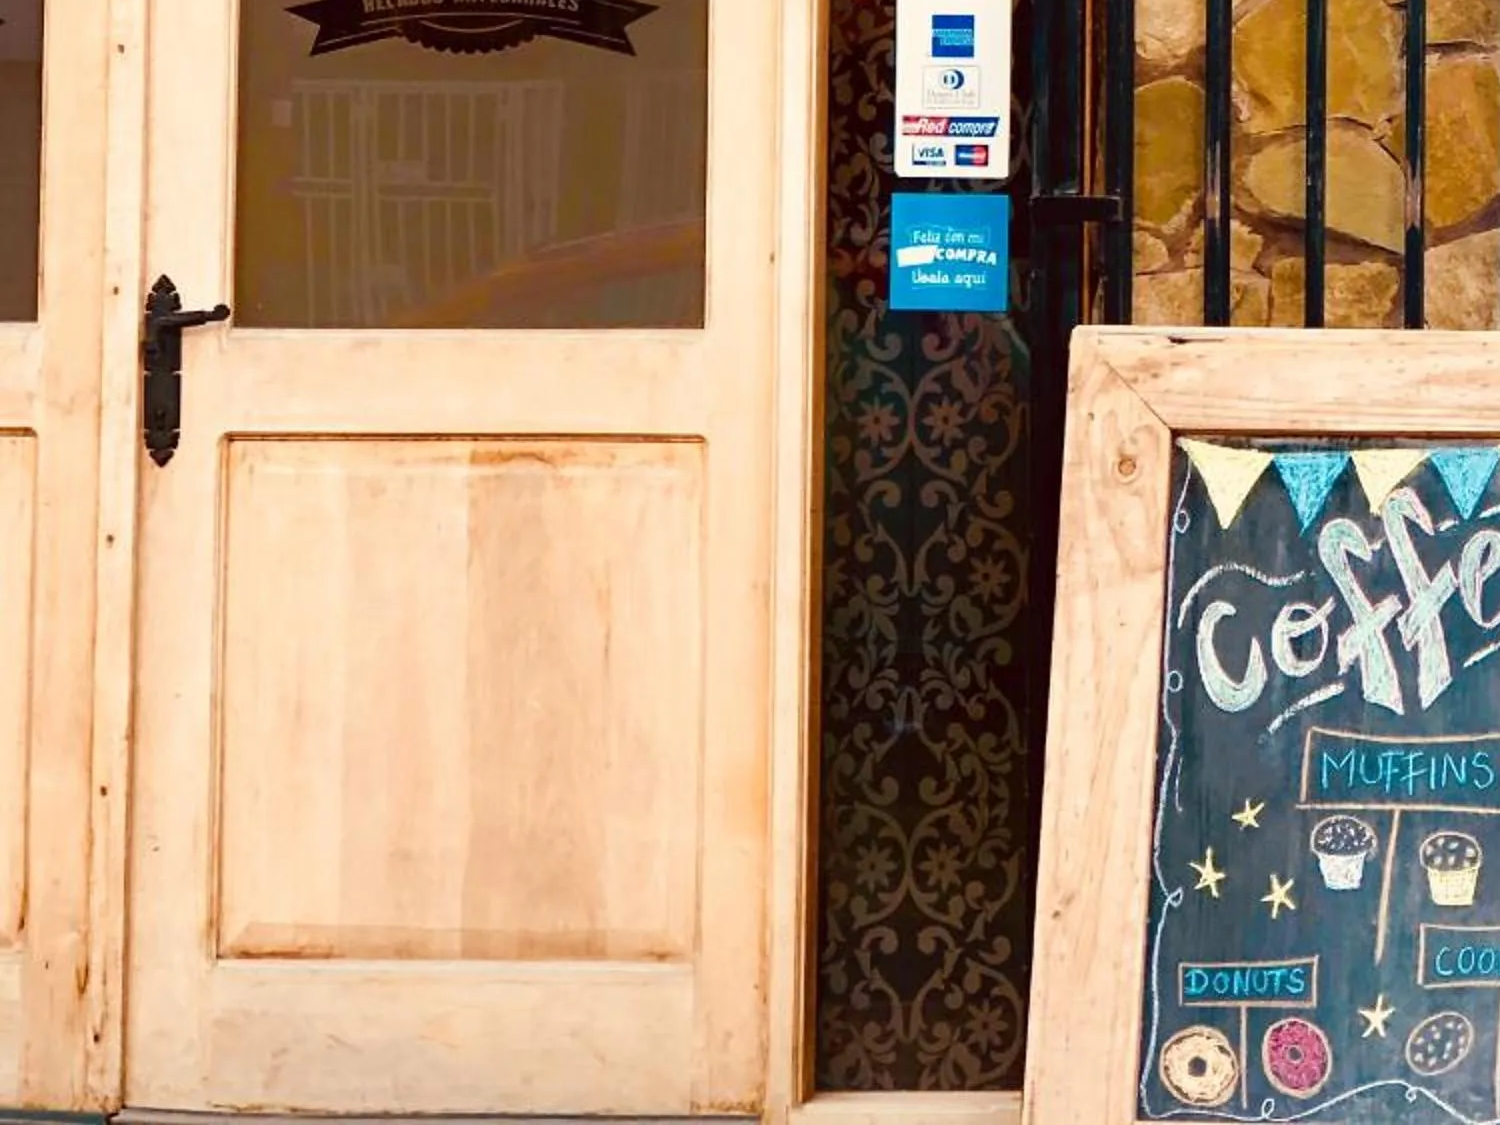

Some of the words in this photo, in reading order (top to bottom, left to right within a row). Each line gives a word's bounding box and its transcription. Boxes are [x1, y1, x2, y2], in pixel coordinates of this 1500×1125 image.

[917, 146, 945, 158] VISA
[935, 246, 998, 267] COMPRA
[1321, 750, 1495, 796] MUFFINS
[1184, 967, 1307, 996] DONUTS
